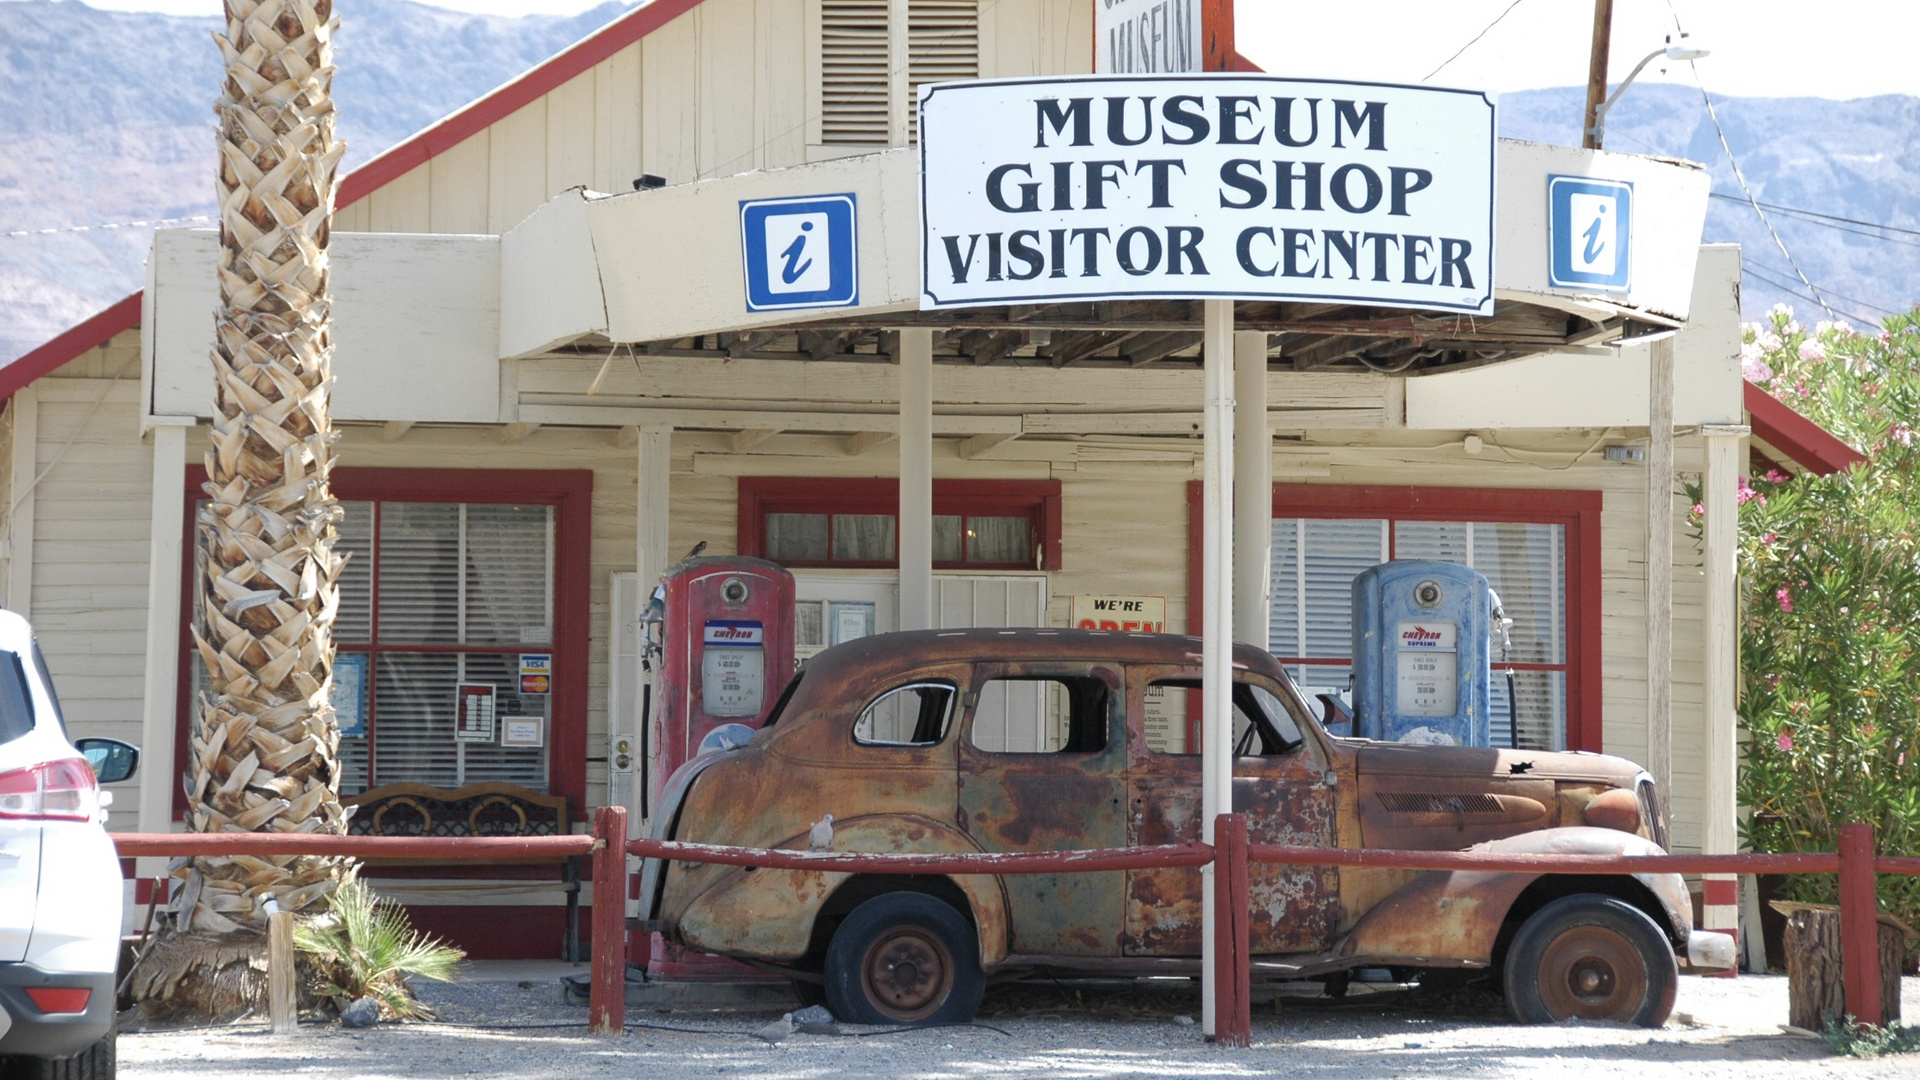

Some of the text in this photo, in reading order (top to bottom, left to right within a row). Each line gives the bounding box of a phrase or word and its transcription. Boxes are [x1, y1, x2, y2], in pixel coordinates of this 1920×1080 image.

[1033, 95, 1388, 151] MUSEUM
[985, 158, 1434, 217] GIFT SHOP
[940, 225, 1476, 290] VISITOR CENTER
[1094, 599, 1144, 612] WE'RE
[714, 626, 752, 639] CHEVRON
[1402, 626, 1441, 640] CHEVRON
